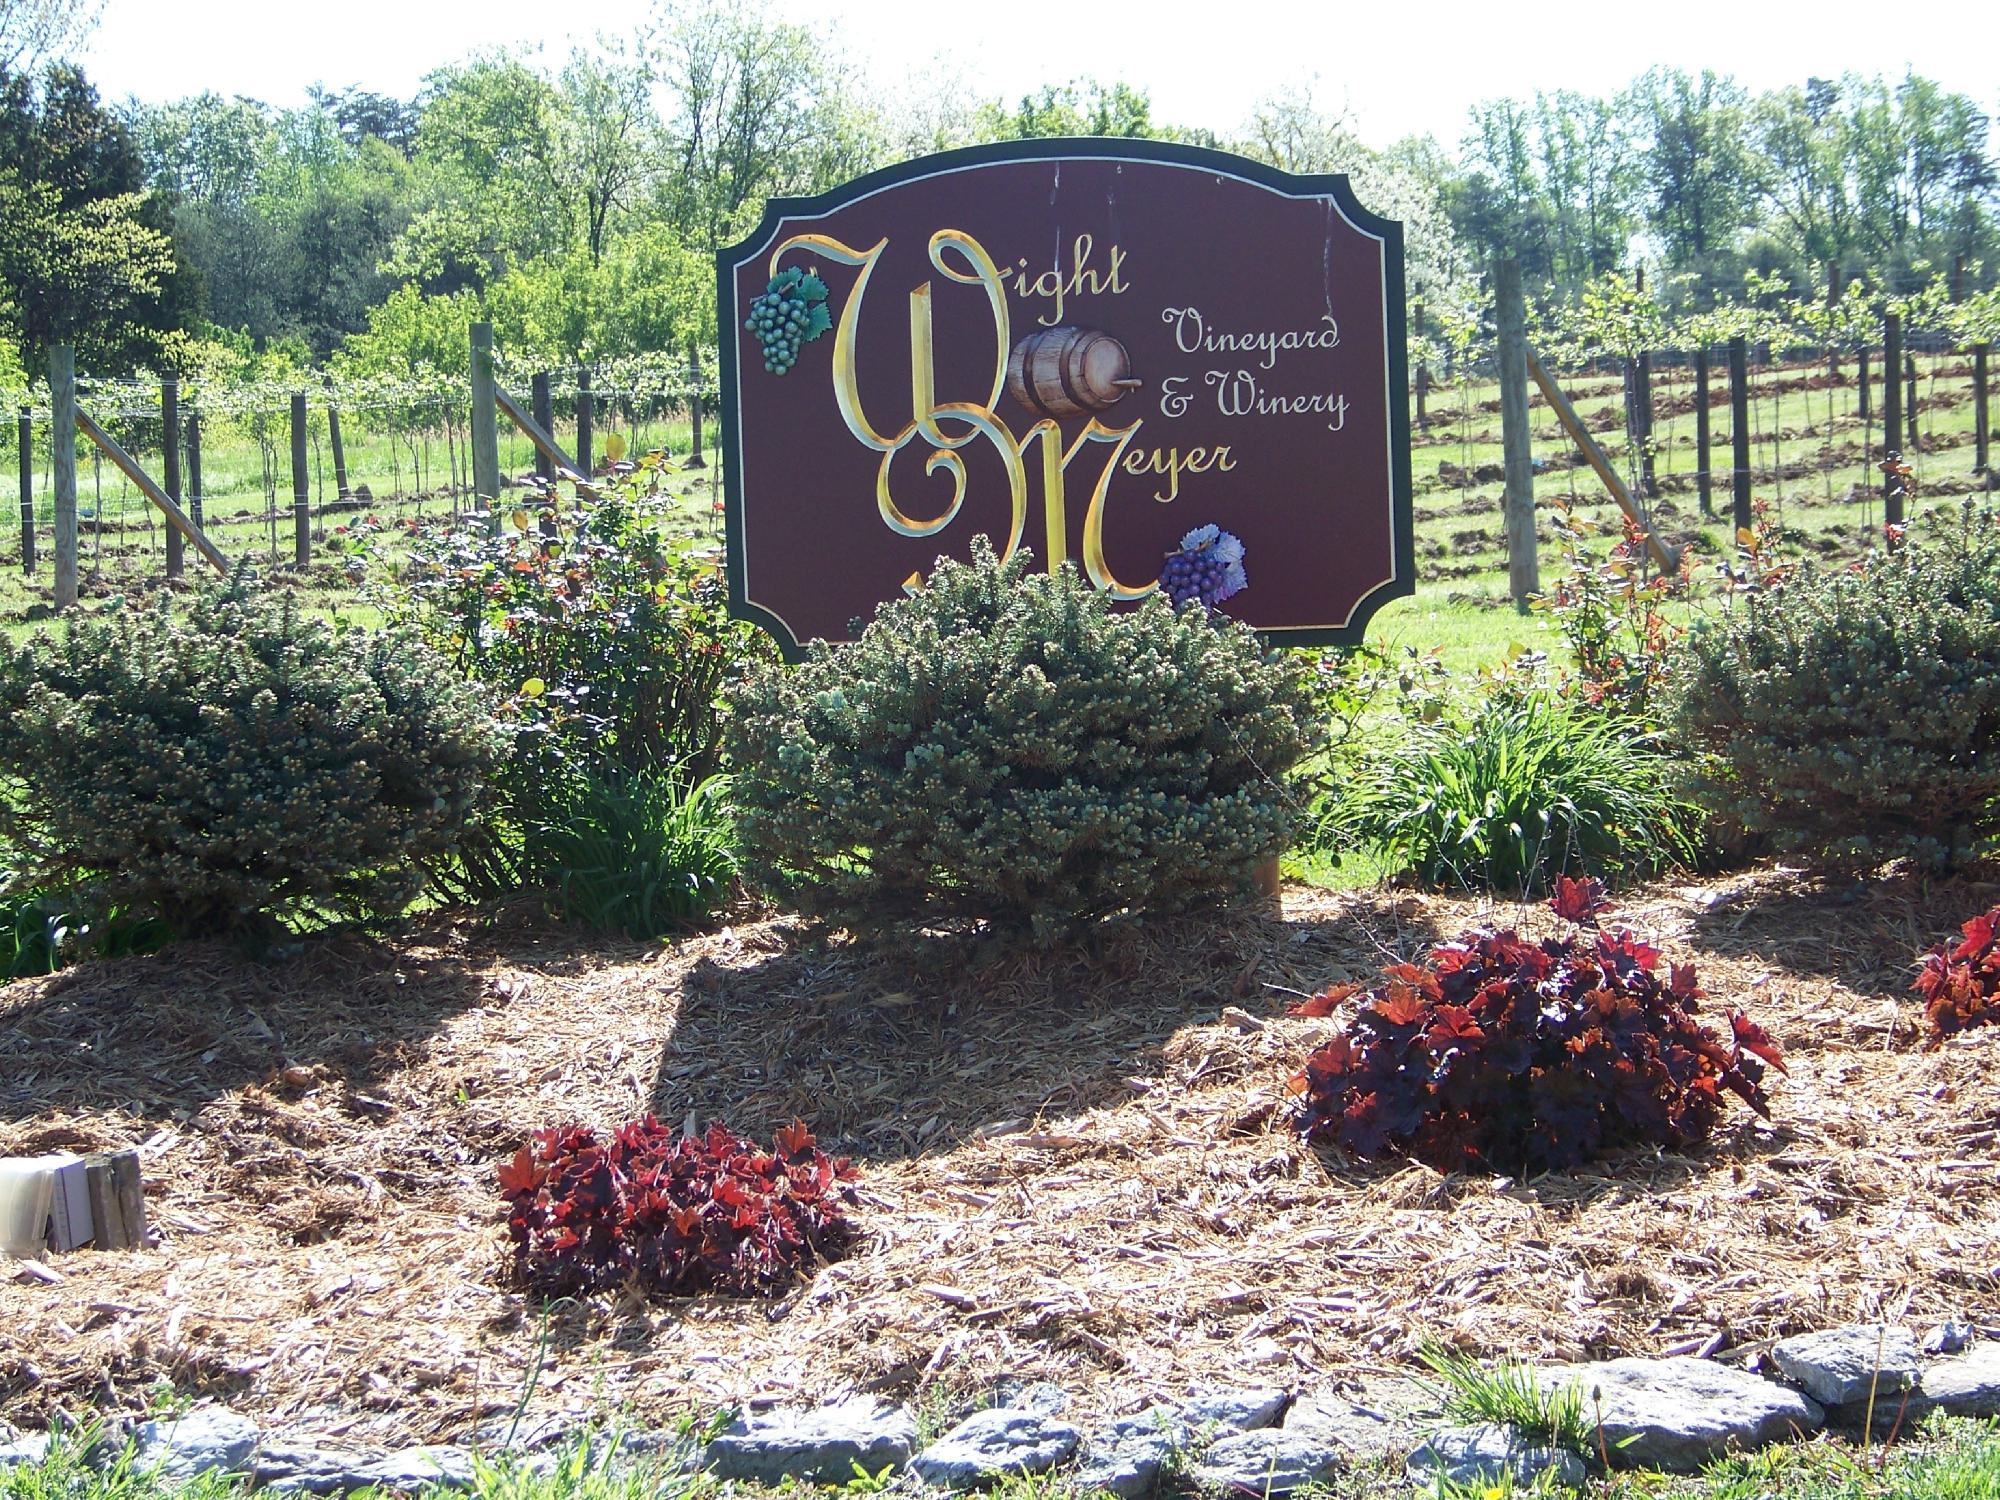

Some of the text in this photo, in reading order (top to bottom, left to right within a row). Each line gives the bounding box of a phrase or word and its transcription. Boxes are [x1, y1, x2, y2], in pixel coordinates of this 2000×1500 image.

[769, 228, 1130, 452] Wight
[1160, 370, 1350, 431] & Winery
[1161, 306, 1342, 370] Vineyard
[876, 401, 1238, 601] Meyer
